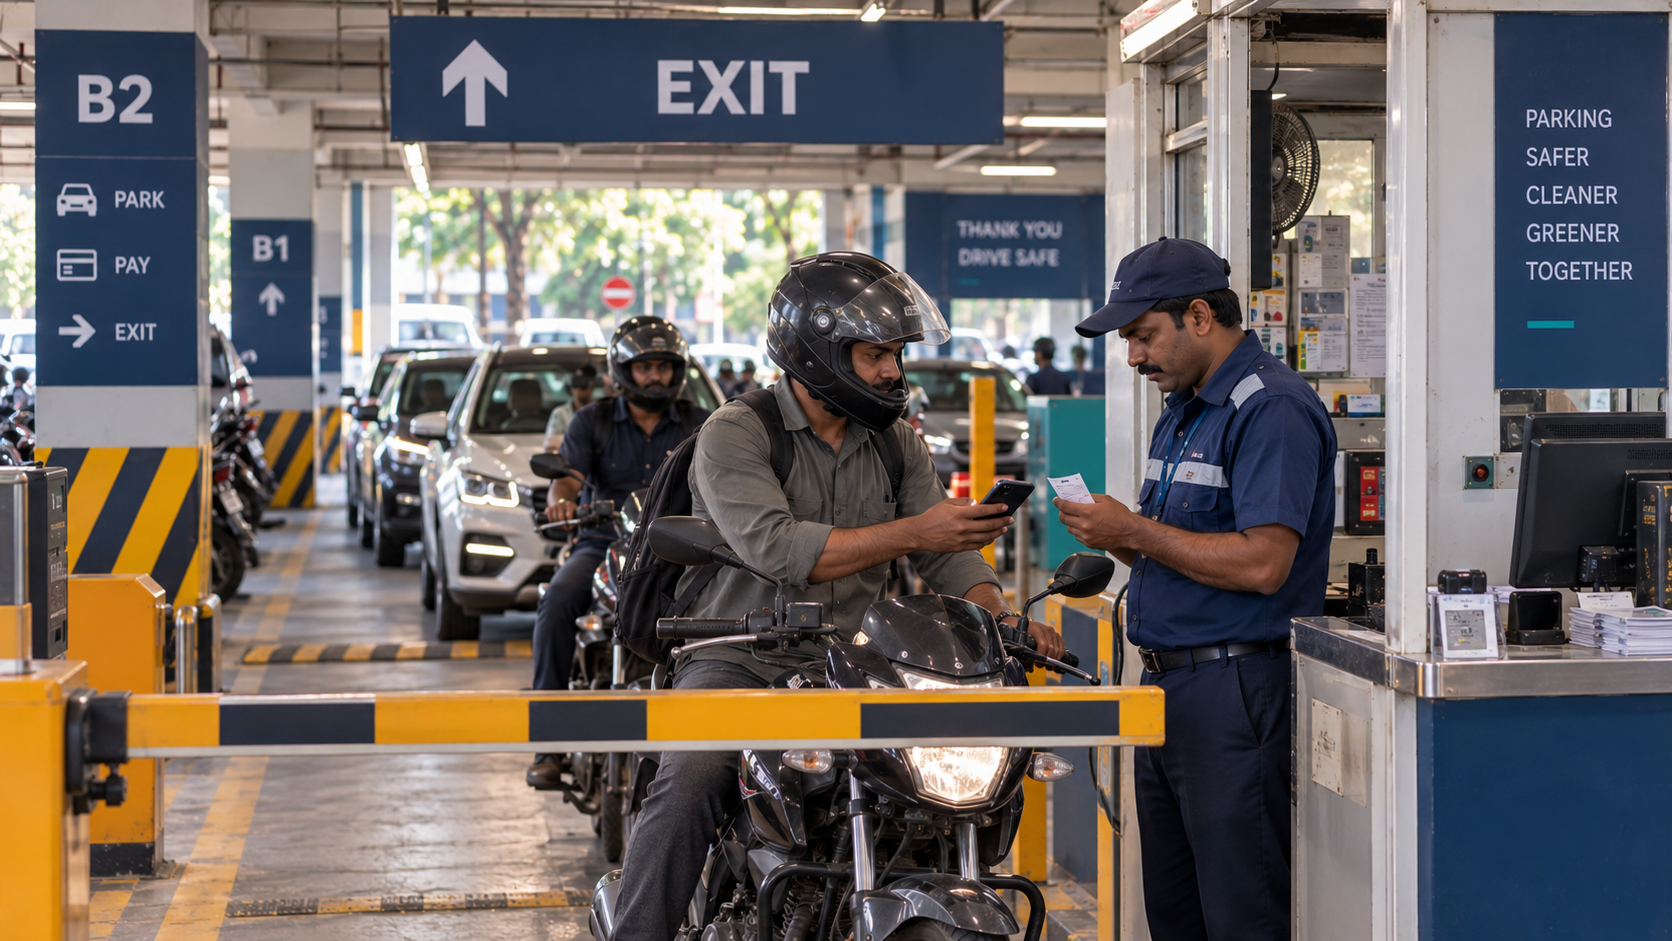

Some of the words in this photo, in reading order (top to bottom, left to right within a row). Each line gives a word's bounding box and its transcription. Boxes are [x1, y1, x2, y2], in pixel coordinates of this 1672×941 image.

[657, 59, 810, 115] EXIT
[77, 74, 154, 124] B2
[1526, 108, 1613, 130] PARKING
[1526, 146, 1590, 167] SAFER
[114, 190, 166, 209] PARK
[1526, 185, 1618, 205] CLEANER
[957, 220, 1020, 239] THANK
[1023, 220, 1063, 239] YOU
[1526, 223, 1620, 243] GREENER
[252, 235, 289, 262] B1
[958, 247, 1012, 267] DRIVE
[1014, 247, 1060, 267] SAFE
[115, 255, 151, 275] PAY
[1525, 260, 1633, 281] TOGETHER
[115, 322, 158, 341] EXIT
